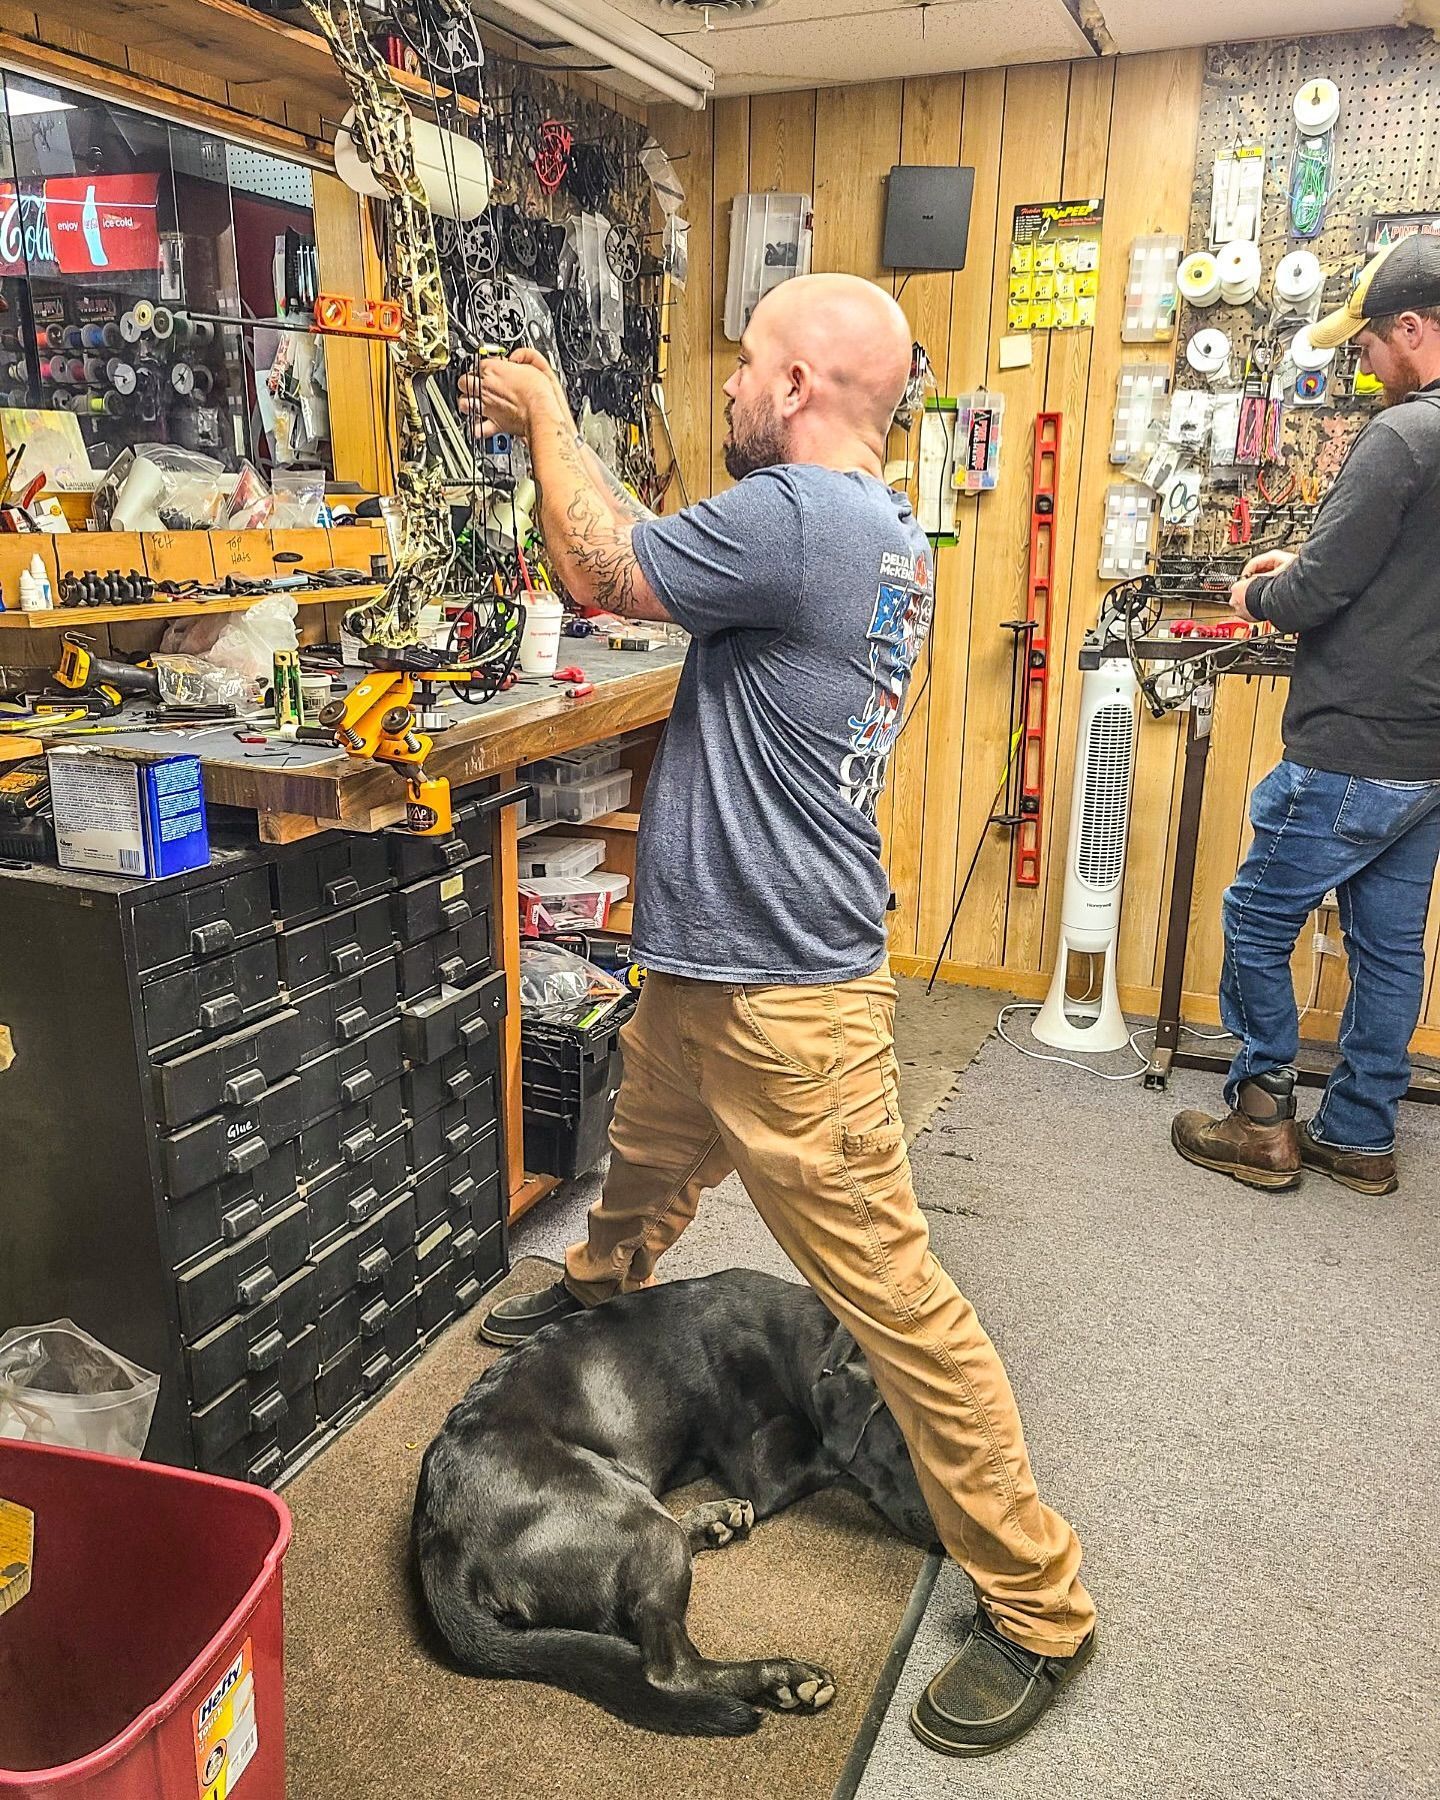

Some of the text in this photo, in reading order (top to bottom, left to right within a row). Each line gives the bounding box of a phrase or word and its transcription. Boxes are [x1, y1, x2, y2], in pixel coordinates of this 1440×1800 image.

[57, 221, 79, 232] enjoy
[102, 218, 115, 229] ice
[116, 216, 134, 228] cold
[971, 424, 980, 467] ARCHERY
[882, 551, 910, 569] DELTA
[227, 1120, 253, 1138] Glue
[201, 1660, 241, 1723] Hefty
[198, 1706, 223, 1742] Touch
